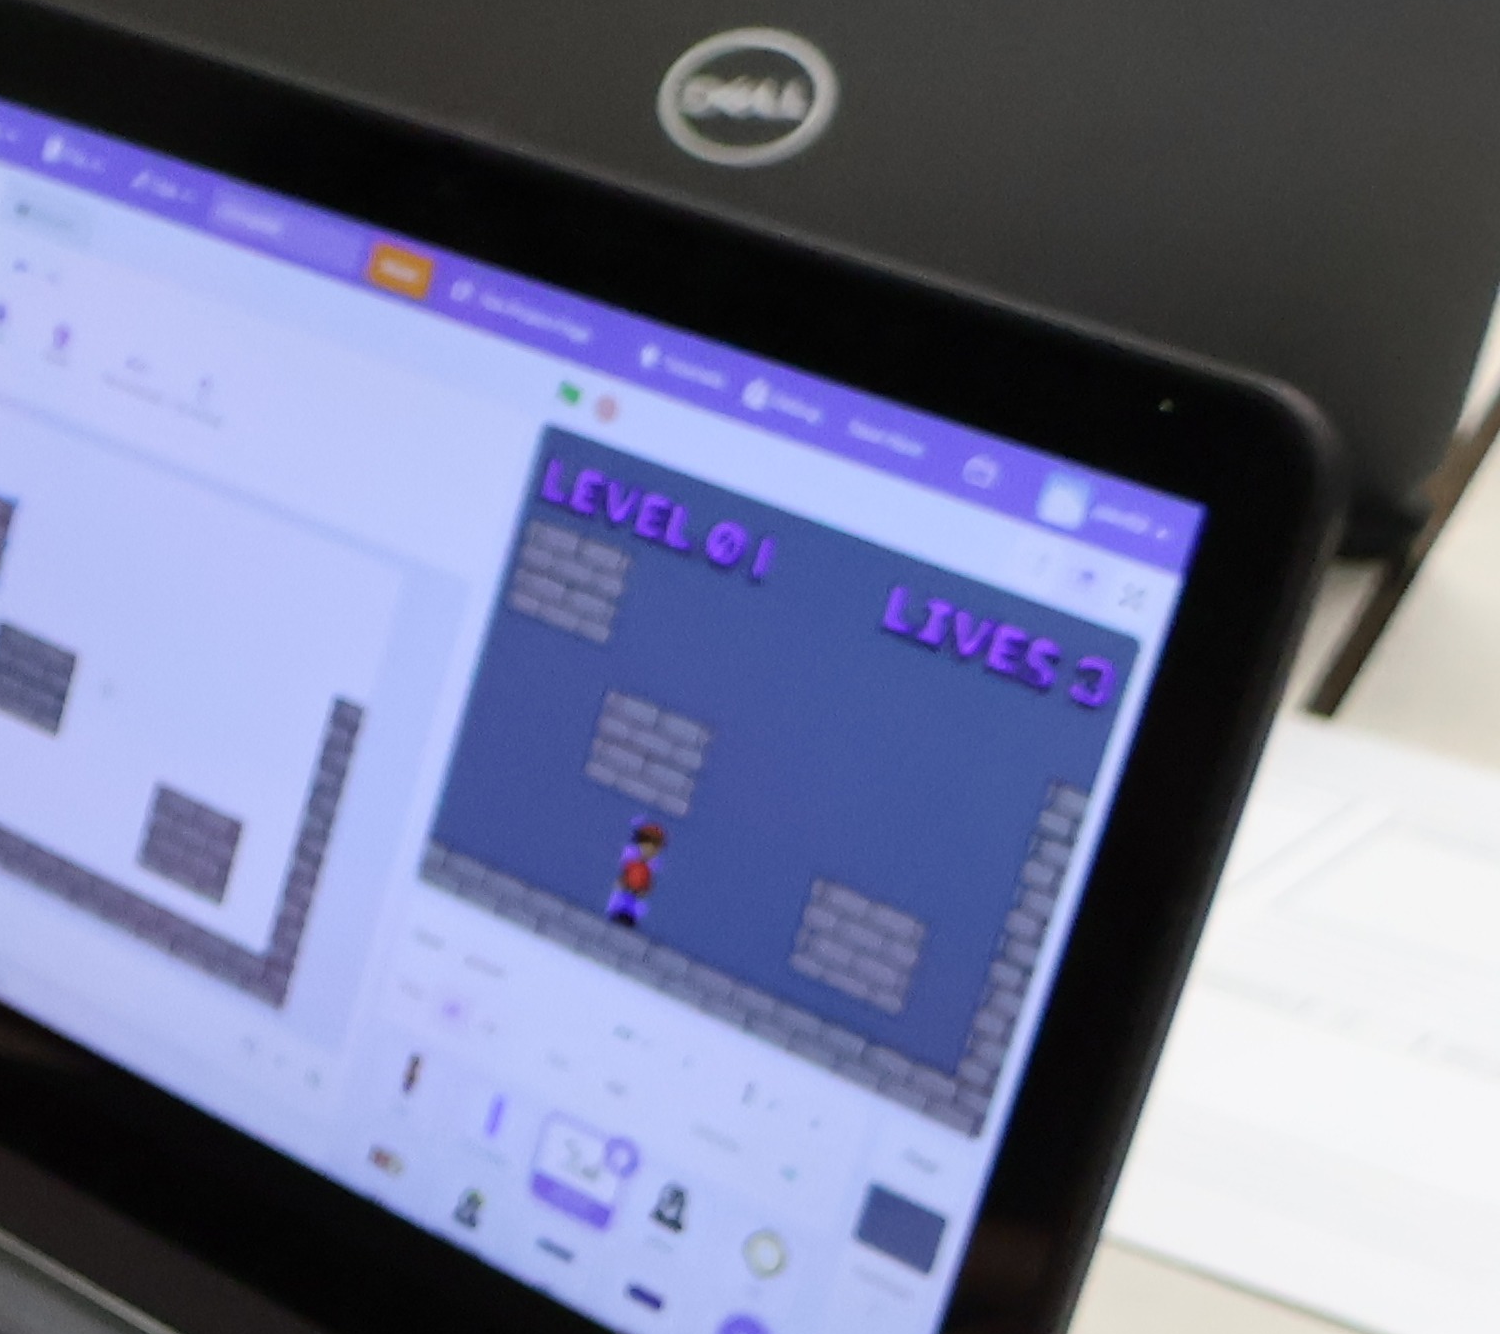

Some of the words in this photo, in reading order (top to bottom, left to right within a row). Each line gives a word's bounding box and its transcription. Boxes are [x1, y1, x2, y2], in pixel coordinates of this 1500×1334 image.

[682, 75, 810, 120] DELL
[541, 458, 692, 551] LEVEL
[883, 584, 1062, 689] LIVES
